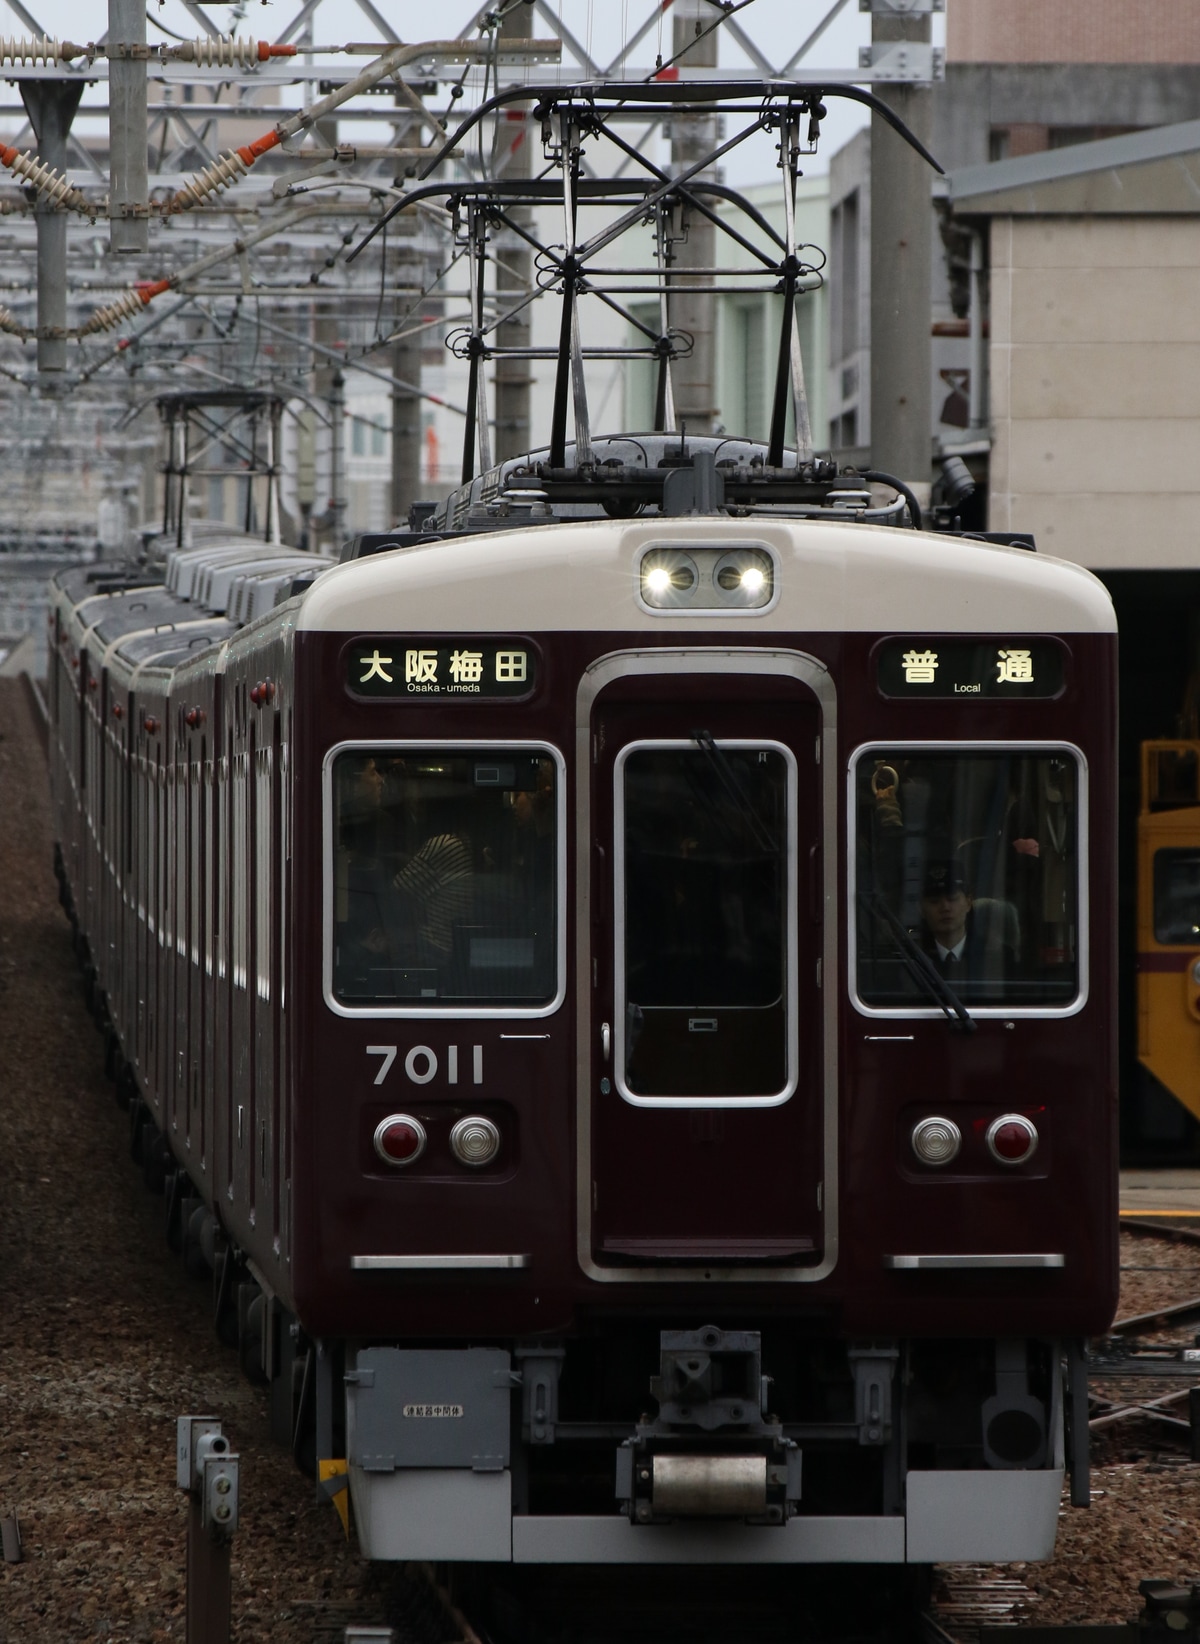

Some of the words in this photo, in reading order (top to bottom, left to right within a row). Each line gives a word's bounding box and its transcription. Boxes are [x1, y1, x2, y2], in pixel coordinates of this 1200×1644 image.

[360, 650, 526, 683] 大阪梅田
[902, 650, 1034, 683] 普通
[407, 683, 480, 692] Osaka-umeda
[954, 683, 980, 692] Local
[366, 1045, 483, 1085] 7011
